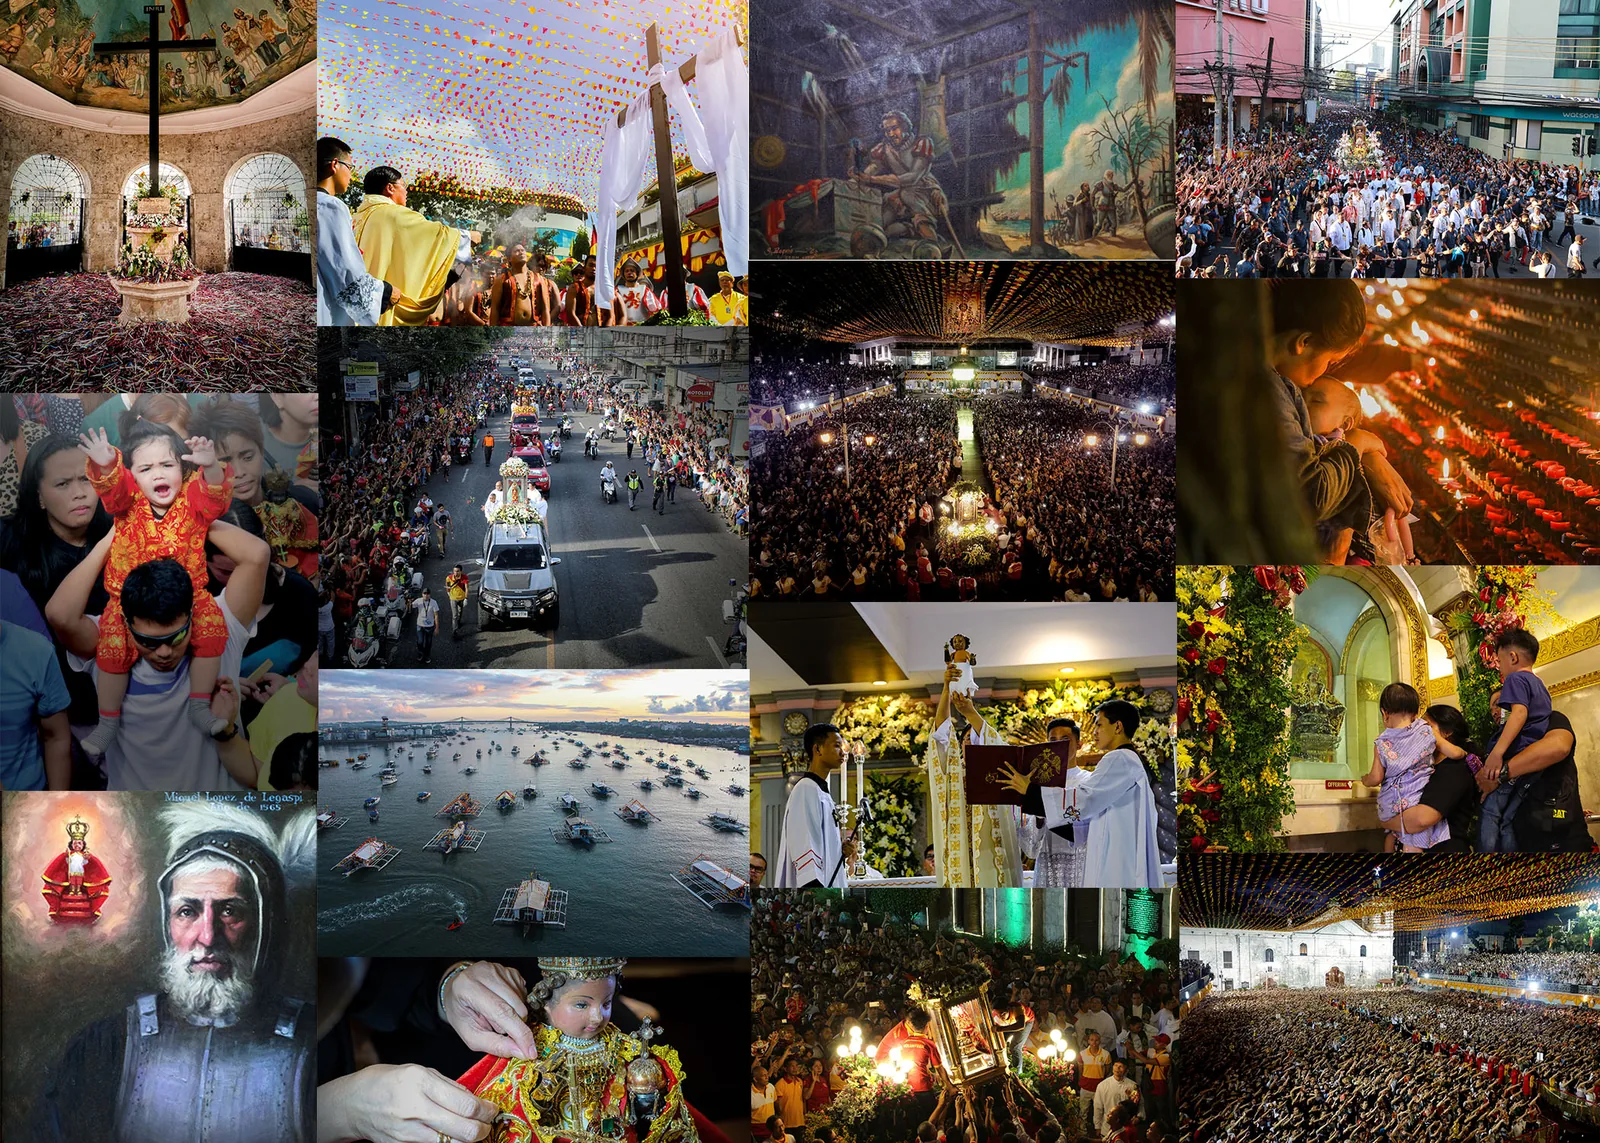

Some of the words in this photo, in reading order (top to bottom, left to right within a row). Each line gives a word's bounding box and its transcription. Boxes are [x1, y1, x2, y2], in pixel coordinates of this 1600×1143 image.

[165, 791, 201, 803] Miguel
[205, 792, 237, 804] Lopez
[244, 792, 257, 802] de
[262, 791, 303, 804] Legaspi
[237, 802, 250, 810] de
